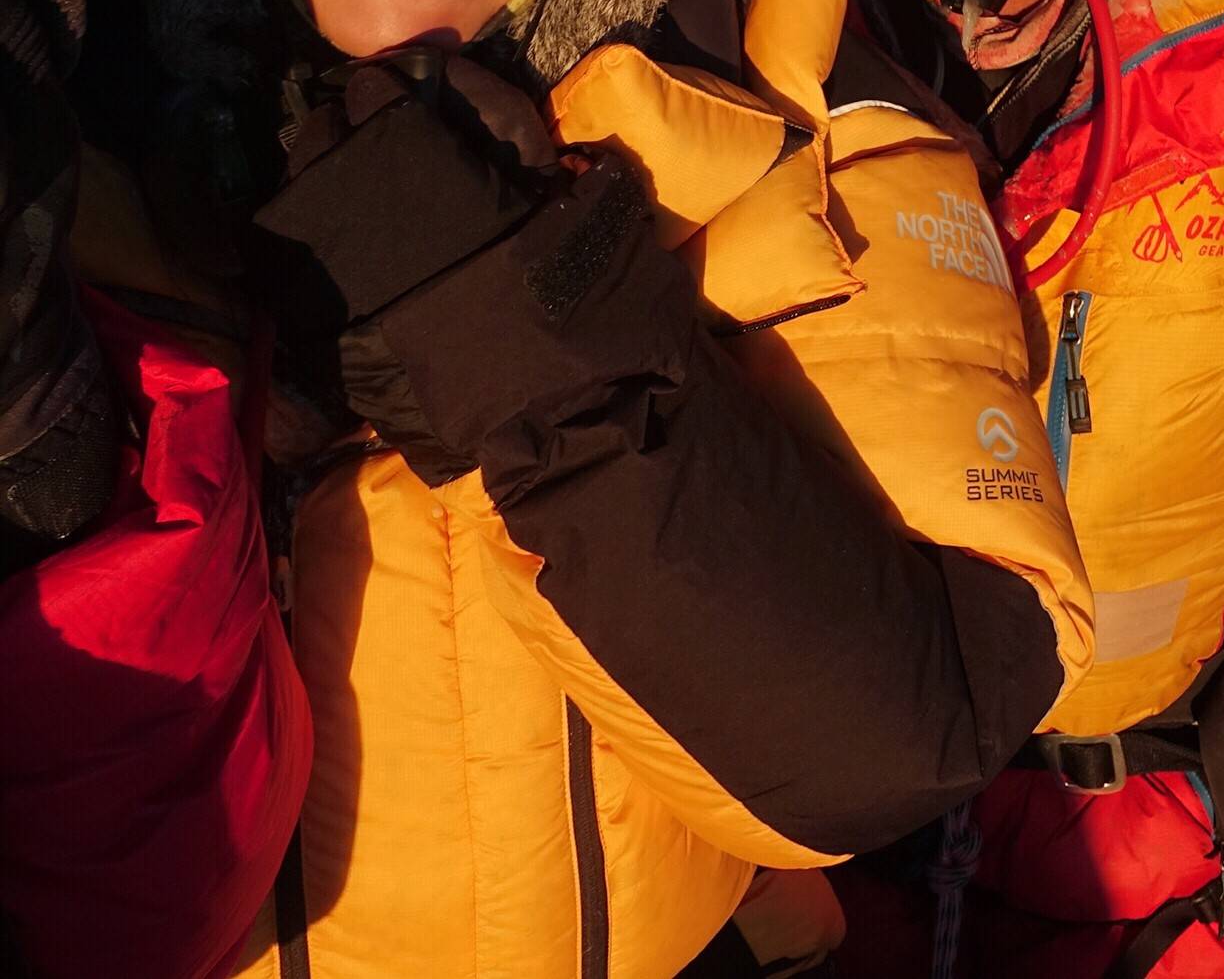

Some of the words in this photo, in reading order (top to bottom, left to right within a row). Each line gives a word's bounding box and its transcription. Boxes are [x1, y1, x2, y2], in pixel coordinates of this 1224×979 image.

[936, 190, 979, 223] THE
[896, 210, 985, 252] NORTH
[928, 242, 987, 281] FACE
[966, 468, 1039, 486] SUMMIT
[967, 485, 1044, 503] SERIES
